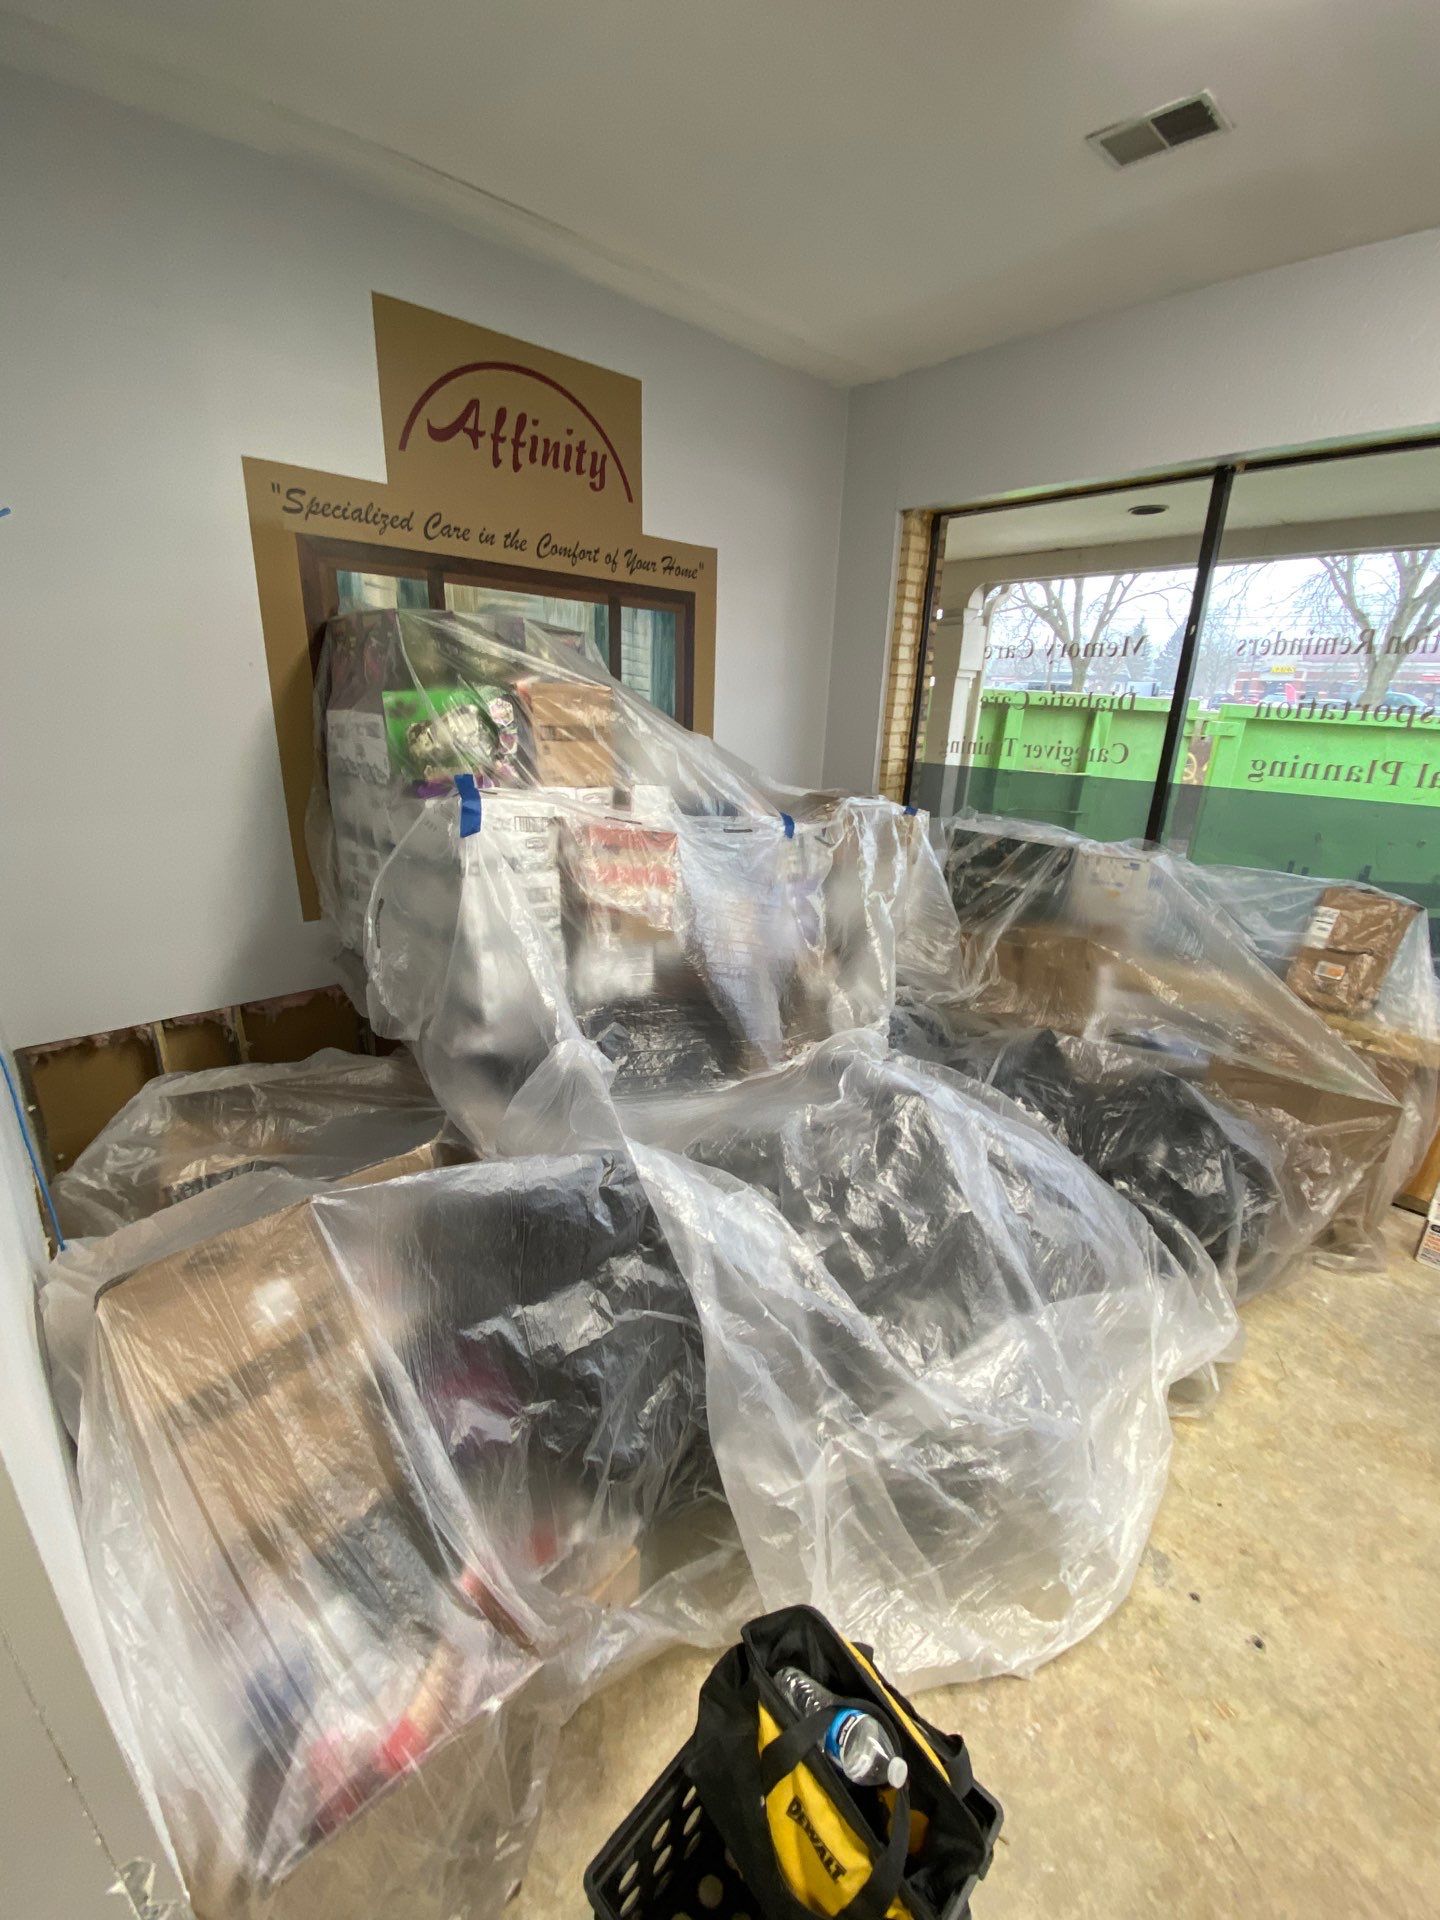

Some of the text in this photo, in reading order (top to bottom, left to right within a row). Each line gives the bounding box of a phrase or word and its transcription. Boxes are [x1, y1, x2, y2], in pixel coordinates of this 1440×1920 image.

[427, 398, 607, 492] Affinity
[271, 482, 415, 535] "Specialized
[423, 512, 470, 541] Care
[478, 527, 496, 546] in
[503, 528, 527, 551] the
[536, 533, 600, 566] Comfort
[604, 548, 619, 572] of
[624, 549, 658, 575] Your
